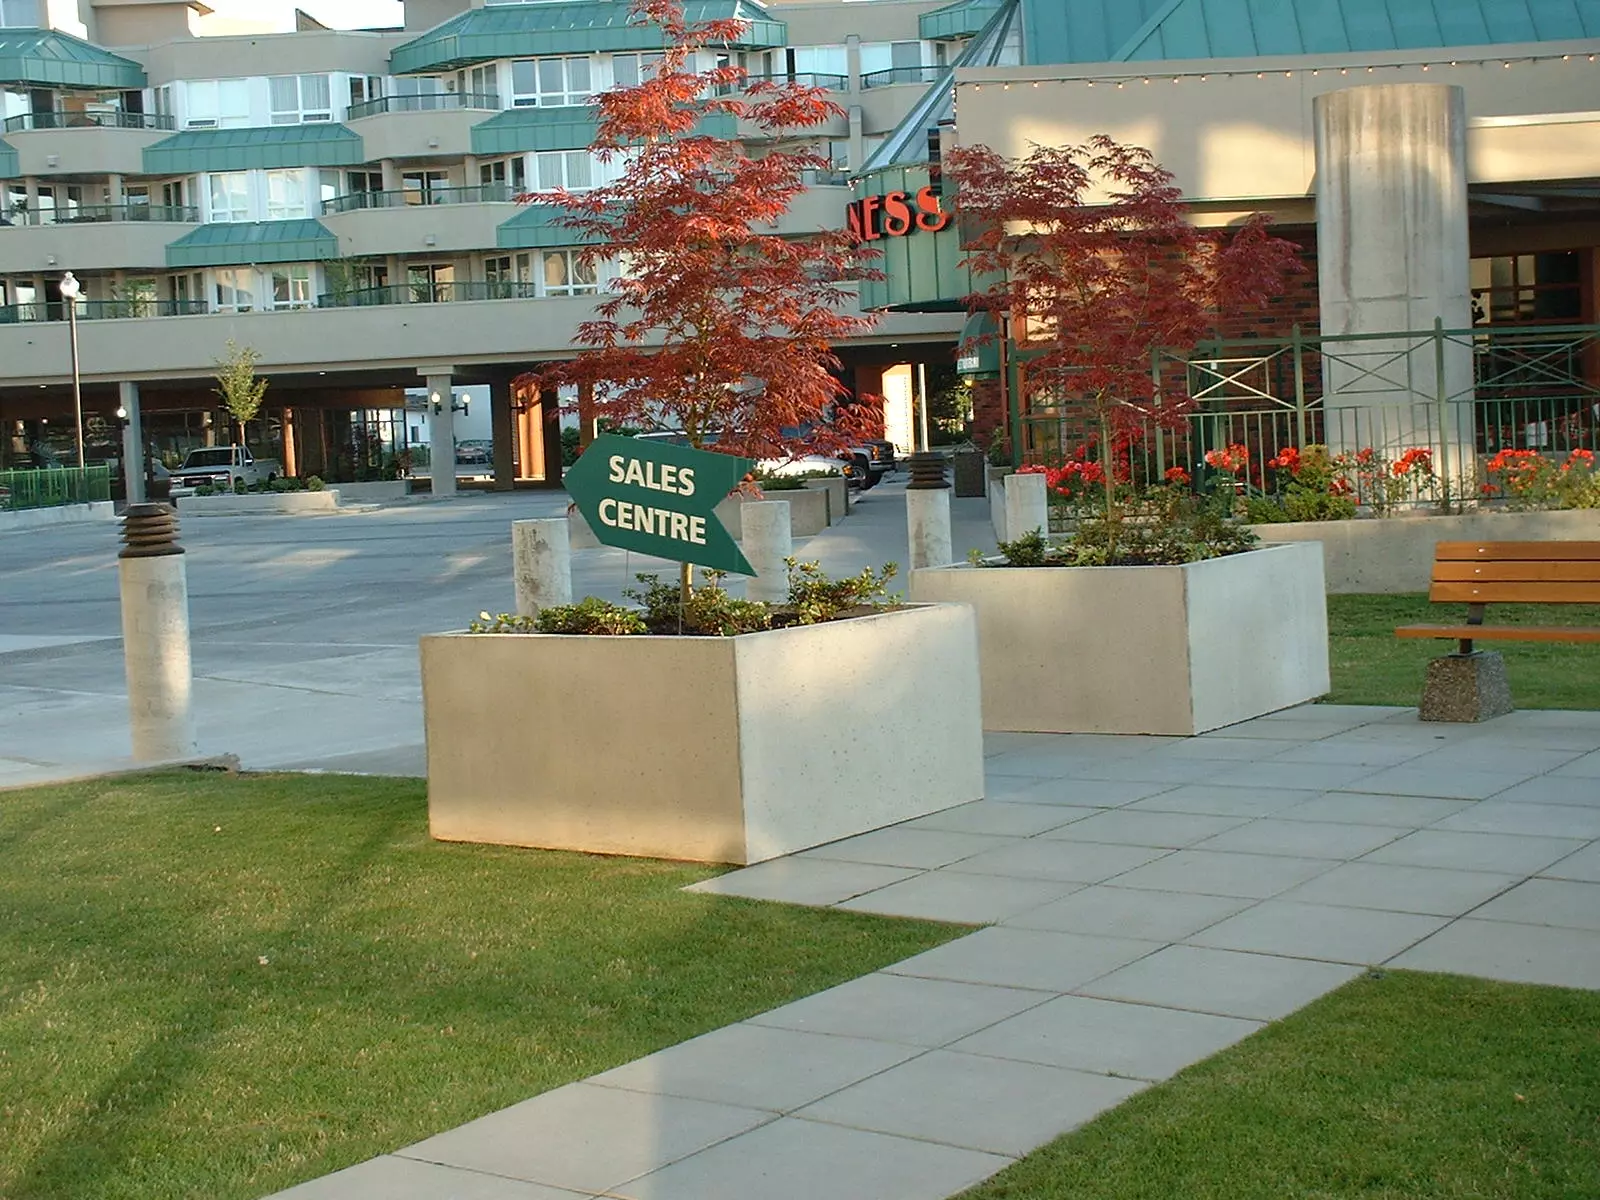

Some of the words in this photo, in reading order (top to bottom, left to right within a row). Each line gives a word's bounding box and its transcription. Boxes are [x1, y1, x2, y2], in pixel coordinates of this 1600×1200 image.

[848, 186, 948, 243] NESS
[608, 455, 695, 496] SALES
[598, 498, 706, 545] CENTRE
